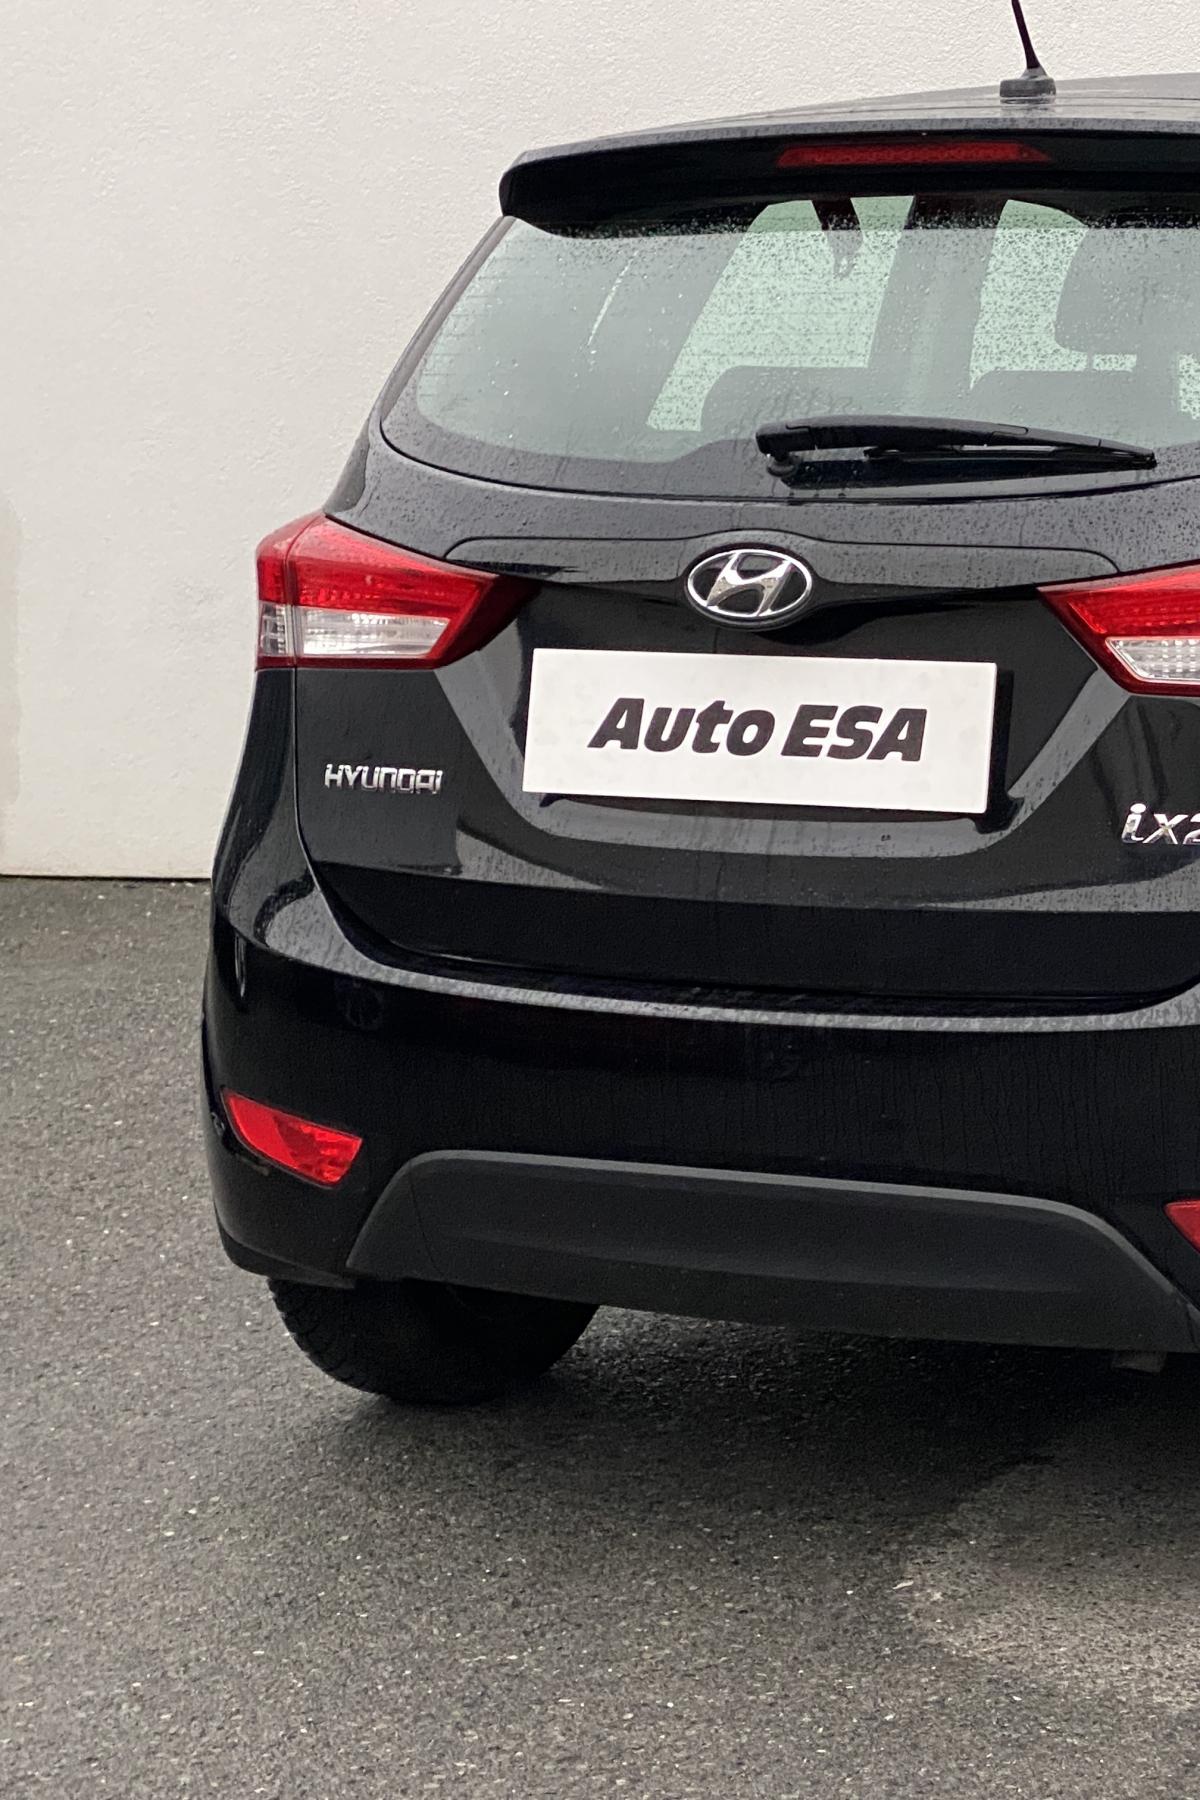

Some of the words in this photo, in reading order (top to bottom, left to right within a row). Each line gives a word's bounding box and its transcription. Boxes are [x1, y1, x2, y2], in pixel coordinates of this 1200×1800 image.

[587, 698, 775, 756] Auto
[781, 704, 927, 761] ESA
[324, 764, 443, 794] HYUNDAI
